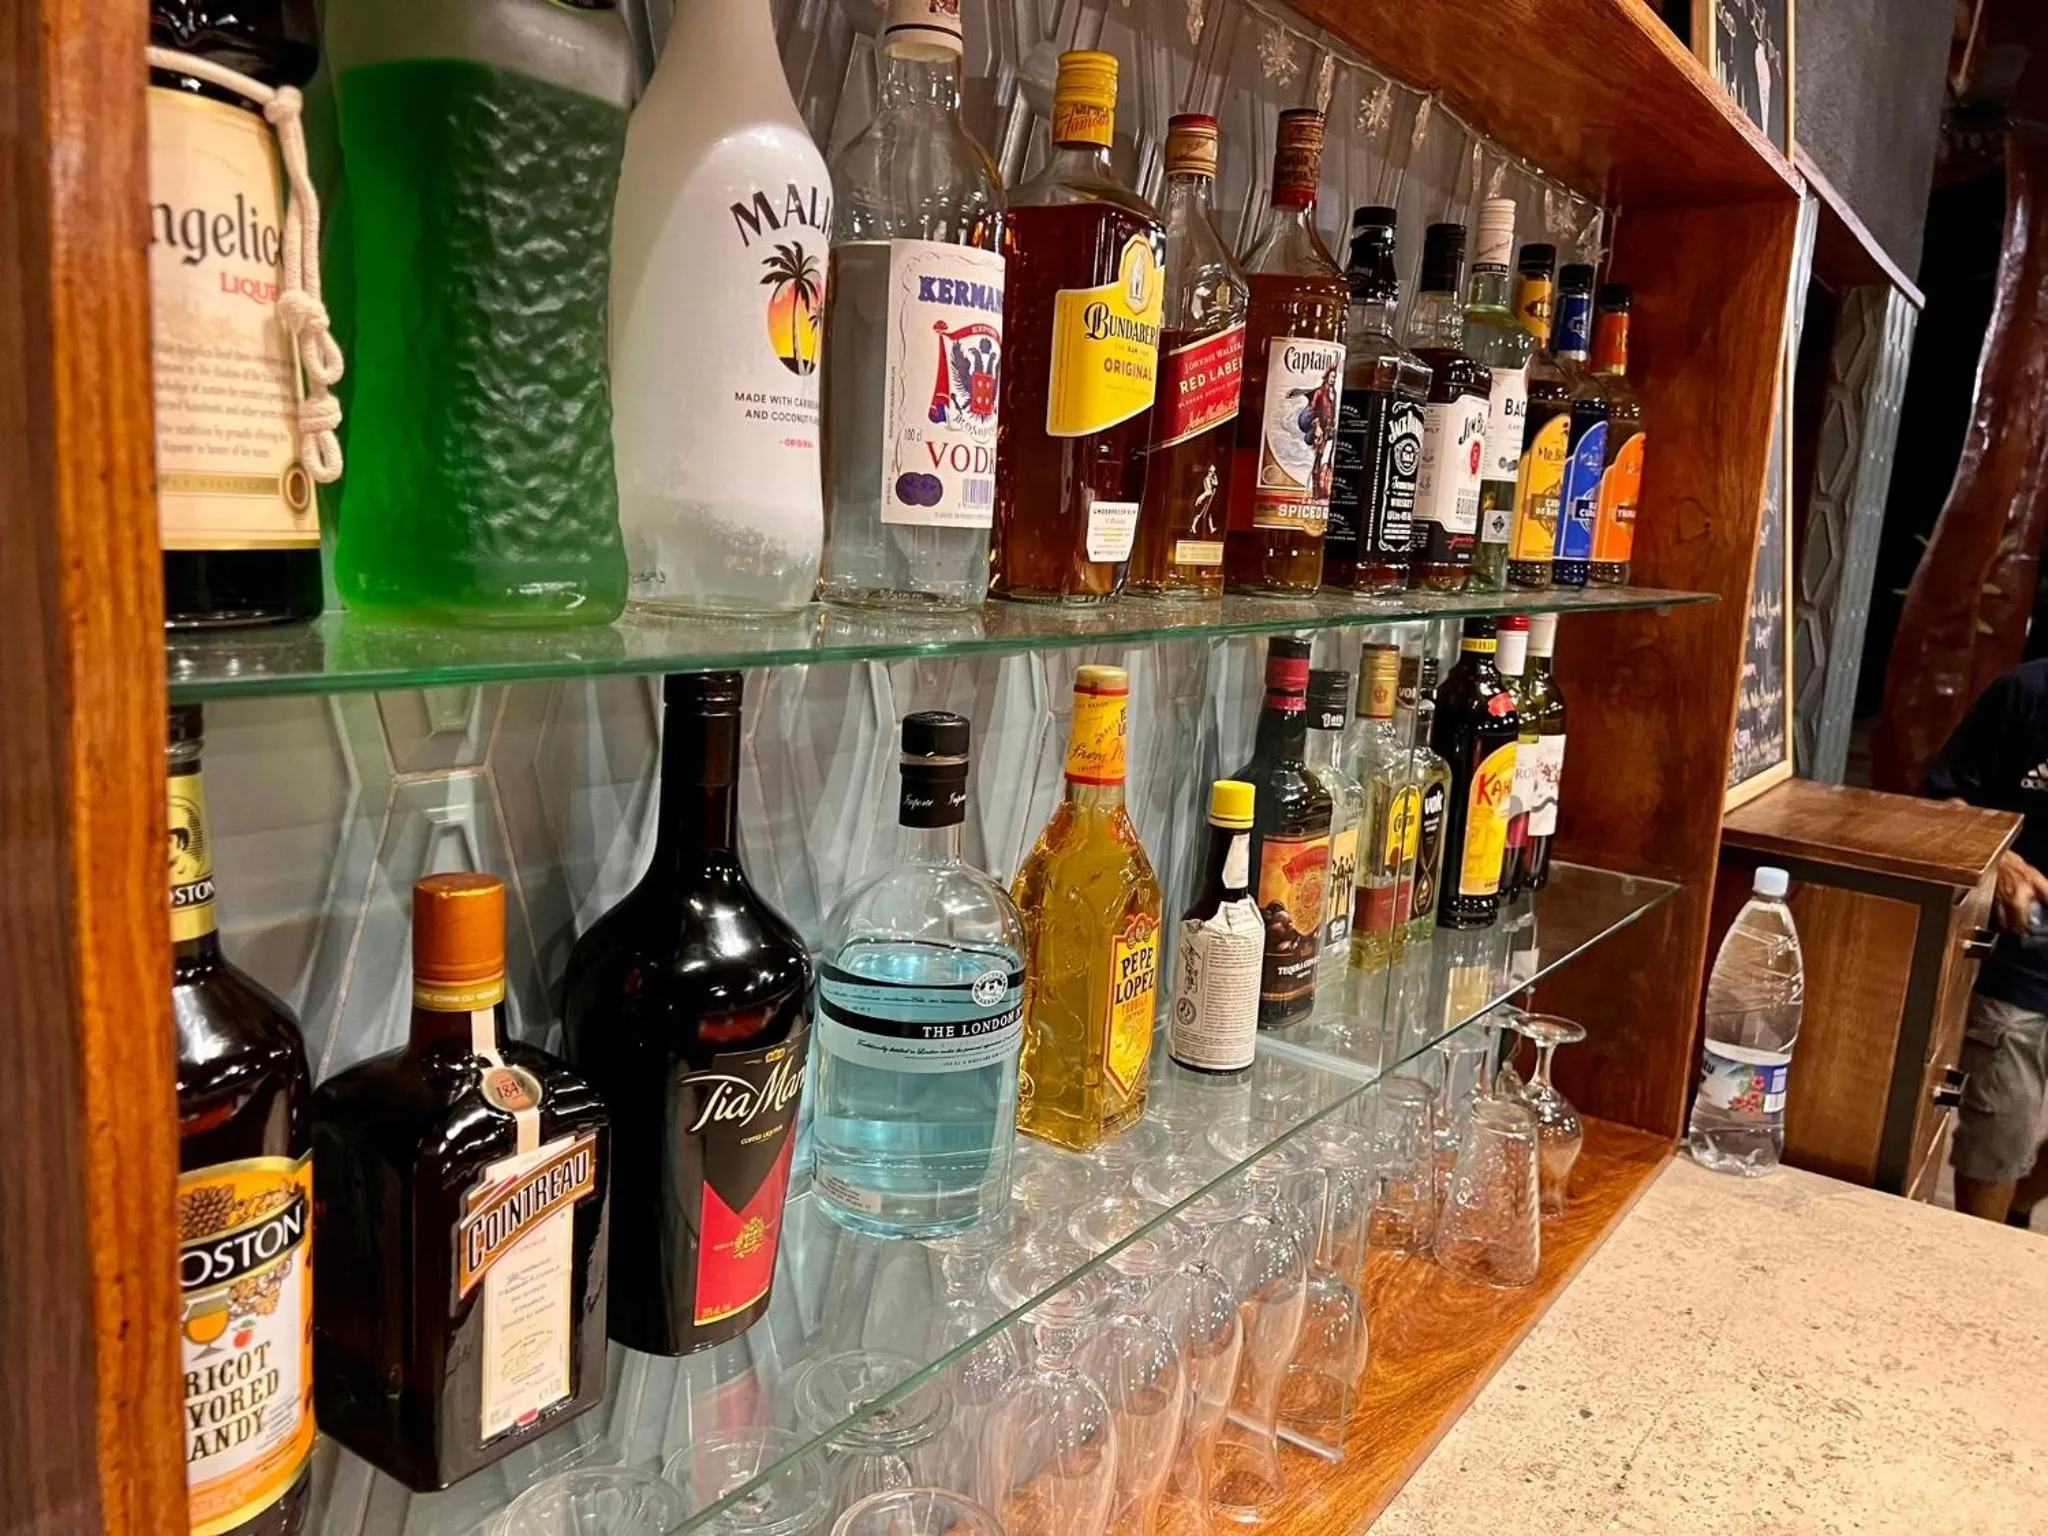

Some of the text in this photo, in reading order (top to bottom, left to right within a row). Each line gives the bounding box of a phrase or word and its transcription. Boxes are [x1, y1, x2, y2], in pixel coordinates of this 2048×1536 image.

[151, 194, 283, 267] ngelic
[730, 184, 831, 247] MALI
[220, 272, 280, 305] LIQUE
[1103, 357, 1152, 382] ORIGINAL
[1284, 346, 1332, 374] Captain
[734, 392, 767, 403] MADE
[770, 394, 793, 407] WITH
[1179, 373, 1207, 395] RED
[745, 409, 768, 420] AND
[926, 440, 995, 475] VOD
[1277, 504, 1323, 519] SPICED
[1121, 946, 1154, 980] PEPE
[1115, 966, 1155, 1006] LOPEZ
[922, 1025, 956, 1039] THE
[962, 1012, 1014, 1037] LONDON
[681, 1074, 760, 1132] Tia
[467, 1149, 591, 1274] COINTREAU
[179, 1200, 304, 1288] OSTON
[184, 1339, 272, 1398] RICOT
[186, 1368, 280, 1431] VORED
[187, 1404, 268, 1463] ANDY
